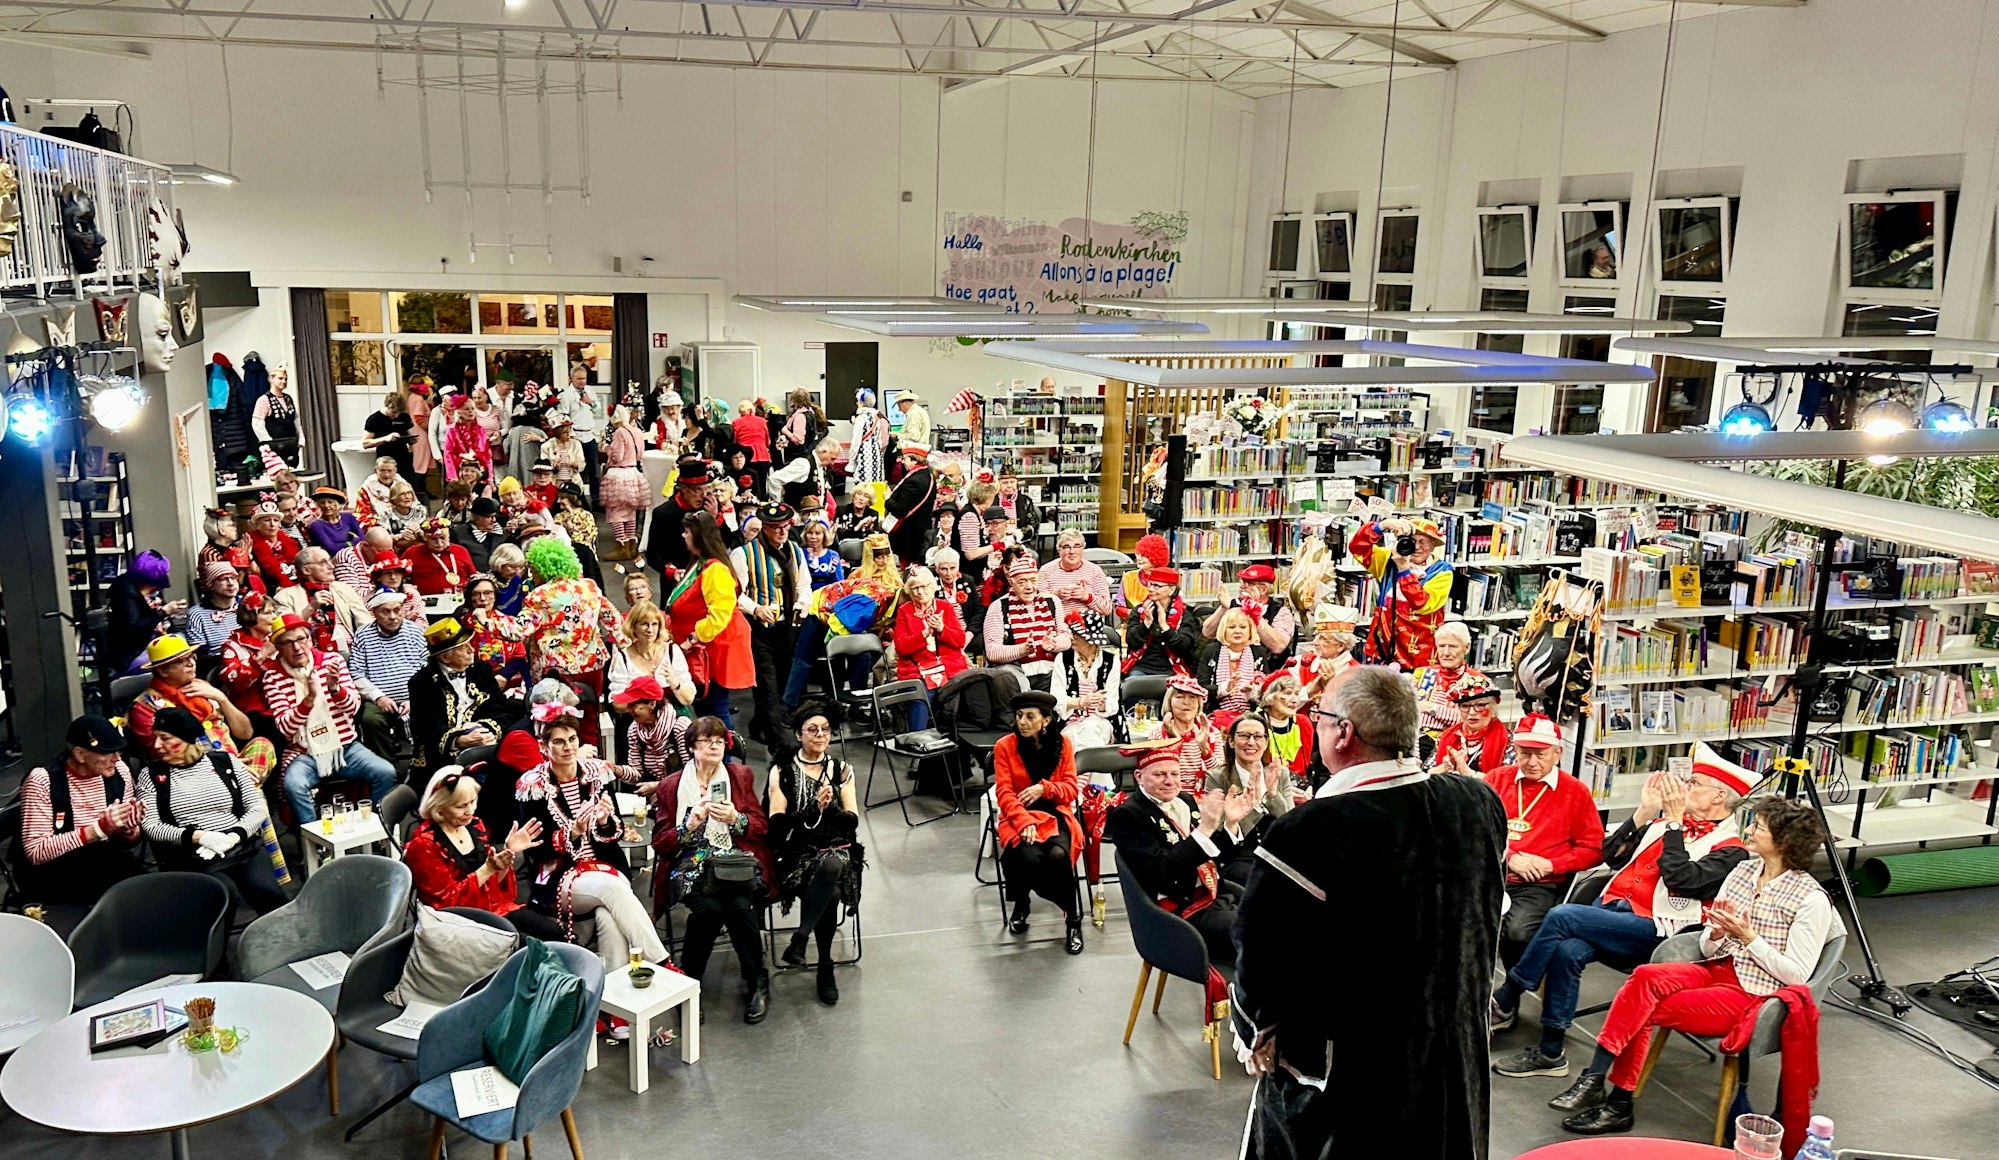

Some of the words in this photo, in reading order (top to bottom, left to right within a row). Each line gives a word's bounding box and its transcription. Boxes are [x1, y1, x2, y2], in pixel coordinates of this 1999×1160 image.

[944, 233, 983, 251] Hallo
[1061, 234, 1181, 263] Rodenkirchen
[1040, 261, 1082, 283] Allons
[1085, 263, 1096, 282] à
[1101, 264, 1112, 283] la
[1116, 262, 1175, 289] plage!
[946, 283, 972, 299] Hoe
[978, 285, 1017, 303] gaat
[480, 1068, 500, 1107] RESERVIERT
